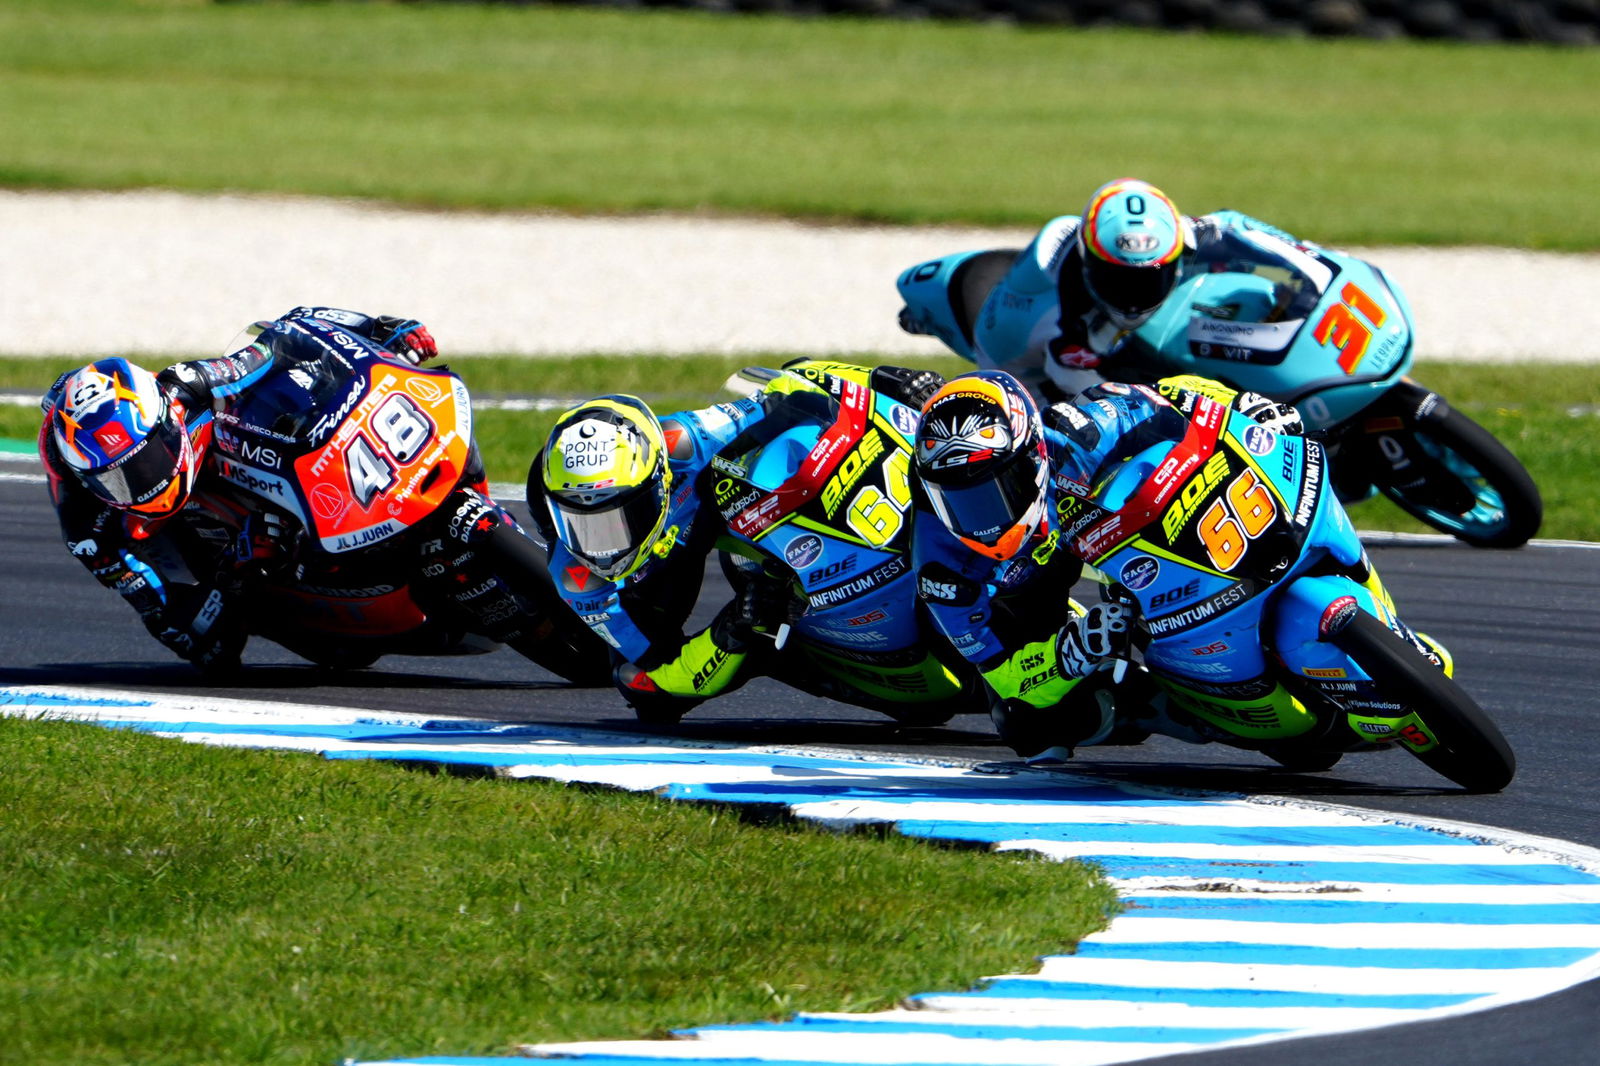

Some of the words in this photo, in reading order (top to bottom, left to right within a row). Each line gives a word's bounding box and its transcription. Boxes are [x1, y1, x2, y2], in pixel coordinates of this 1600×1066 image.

[1313, 281, 1387, 375] 31
[241, 441, 283, 470] MSi
[342, 391, 437, 513] 48
[565, 440, 610, 455] PONT
[565, 454, 609, 469] GRUP
[931, 448, 994, 471] LS2
[1281, 438, 1295, 483] BOE
[1305, 438, 1321, 465] FEST
[714, 456, 747, 477] WRS
[820, 428, 884, 514] BOE
[136, 479, 169, 503] GALFER
[846, 447, 912, 549] 64
[1056, 475, 1089, 497] WRS
[1161, 450, 1229, 540] BOE
[1295, 463, 1320, 527] INFINITUM
[737, 494, 780, 530] LS2
[1197, 466, 1277, 573] 66
[973, 526, 1002, 537] GALFER
[1078, 515, 1121, 554] LS2
[786, 537, 817, 560] FACE
[809, 575, 876, 608] INFINITUM
[873, 556, 907, 584] FEST
[1122, 560, 1155, 582] FACE
[1147, 602, 1215, 635] INFINITUM
[1213, 583, 1248, 611] FEST
[1150, 578, 1201, 609] BOE
[1370, 699, 1401, 711] Solutions
